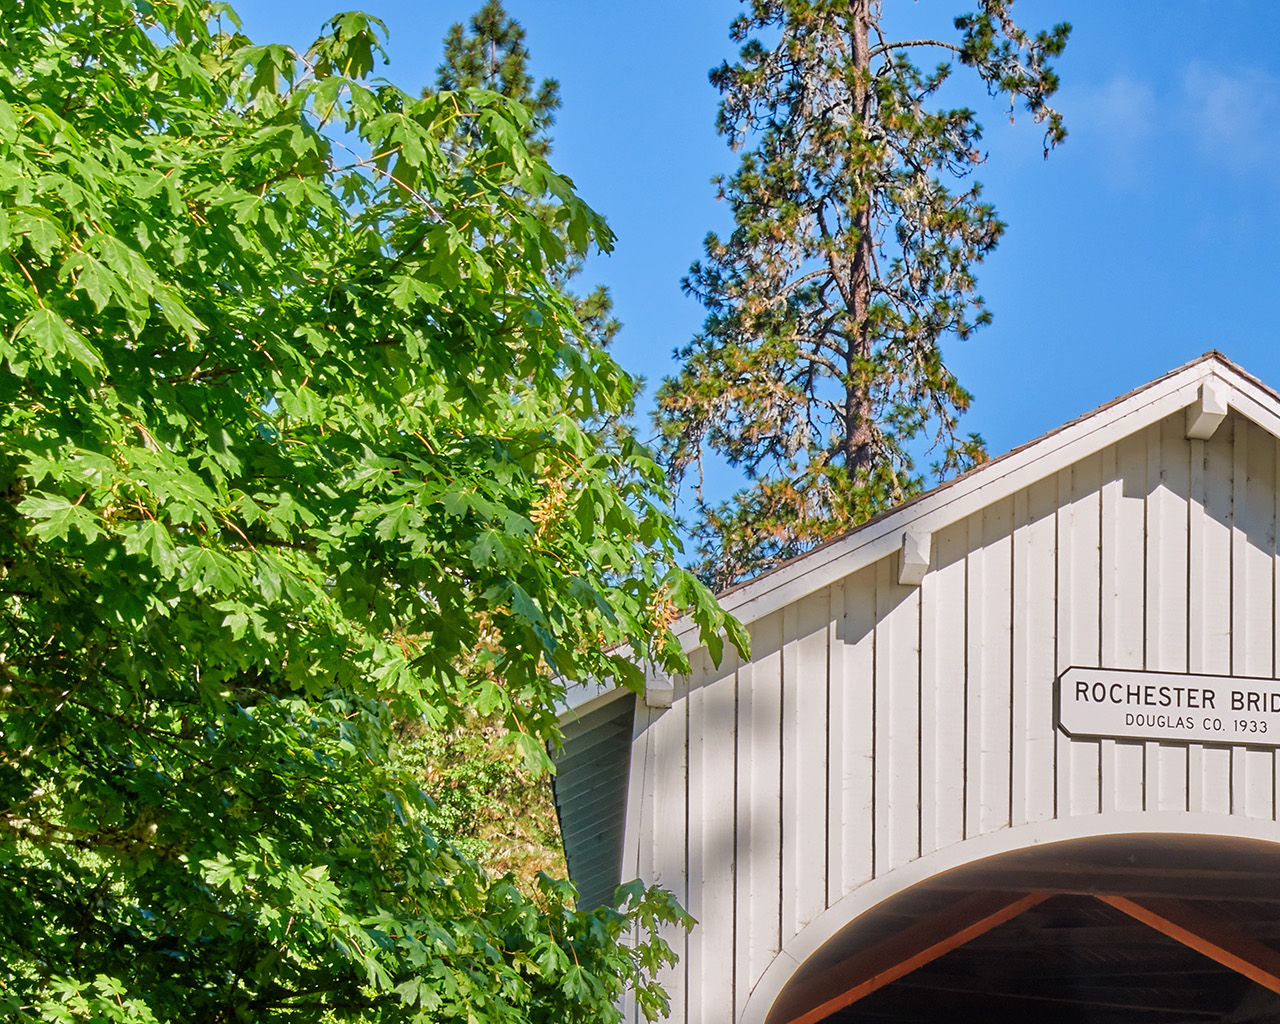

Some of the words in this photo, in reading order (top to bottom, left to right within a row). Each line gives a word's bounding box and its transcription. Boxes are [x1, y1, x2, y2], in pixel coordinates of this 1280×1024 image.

[1075, 680, 1216, 710] ROCHESTER
[1125, 713, 1195, 730] DOUGLAS
[1202, 717, 1226, 732] CO.
[1233, 719, 1268, 734] 1933
